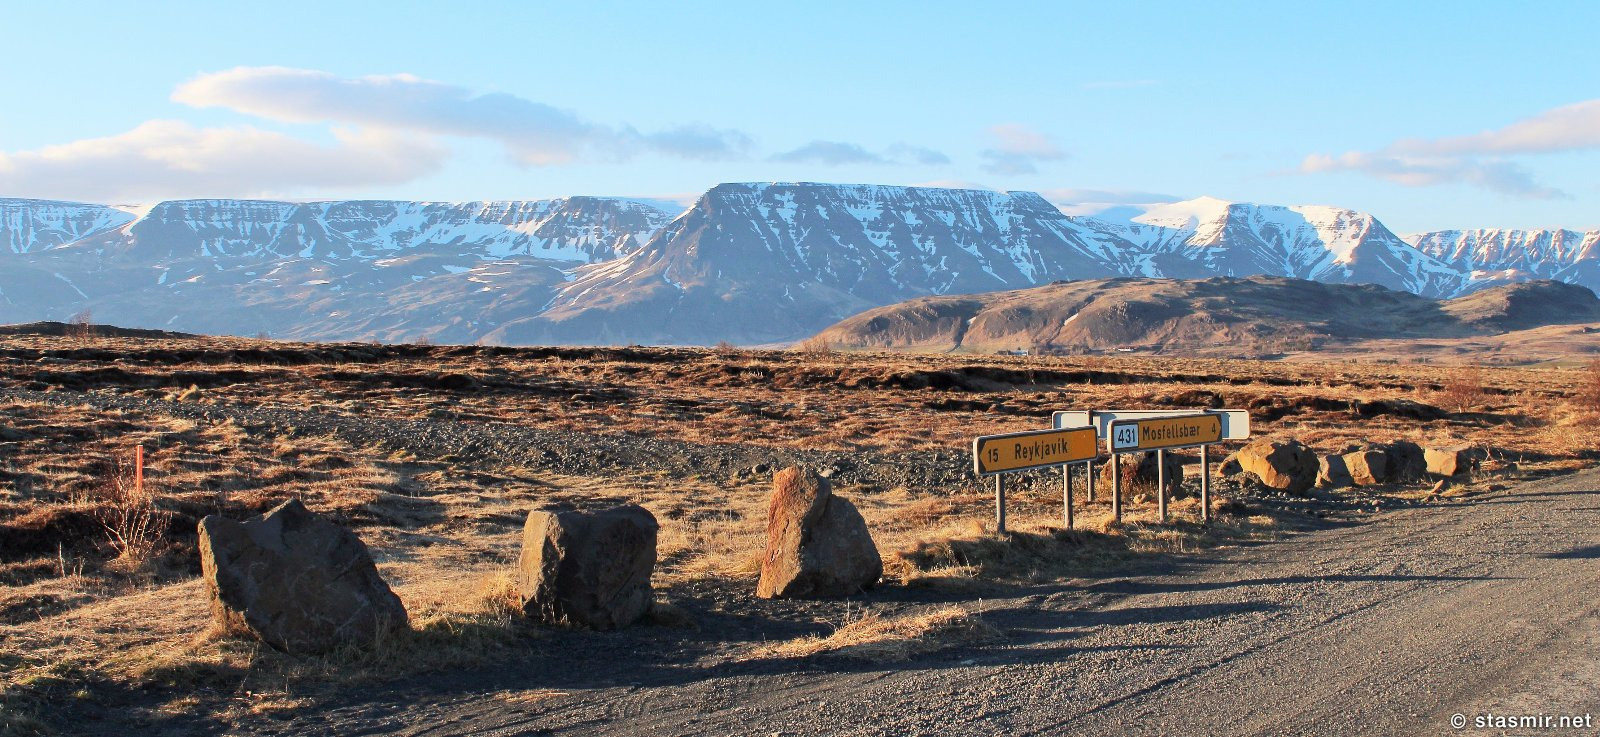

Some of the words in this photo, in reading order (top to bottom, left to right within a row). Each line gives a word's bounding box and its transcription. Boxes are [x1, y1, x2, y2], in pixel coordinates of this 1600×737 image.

[1117, 428, 1136, 444] 431
[1142, 424, 1200, 441] Mosfellsbær
[1211, 423, 1217, 435] 4
[987, 448, 999, 463] 15
[1014, 438, 1068, 461] Reykjavík
